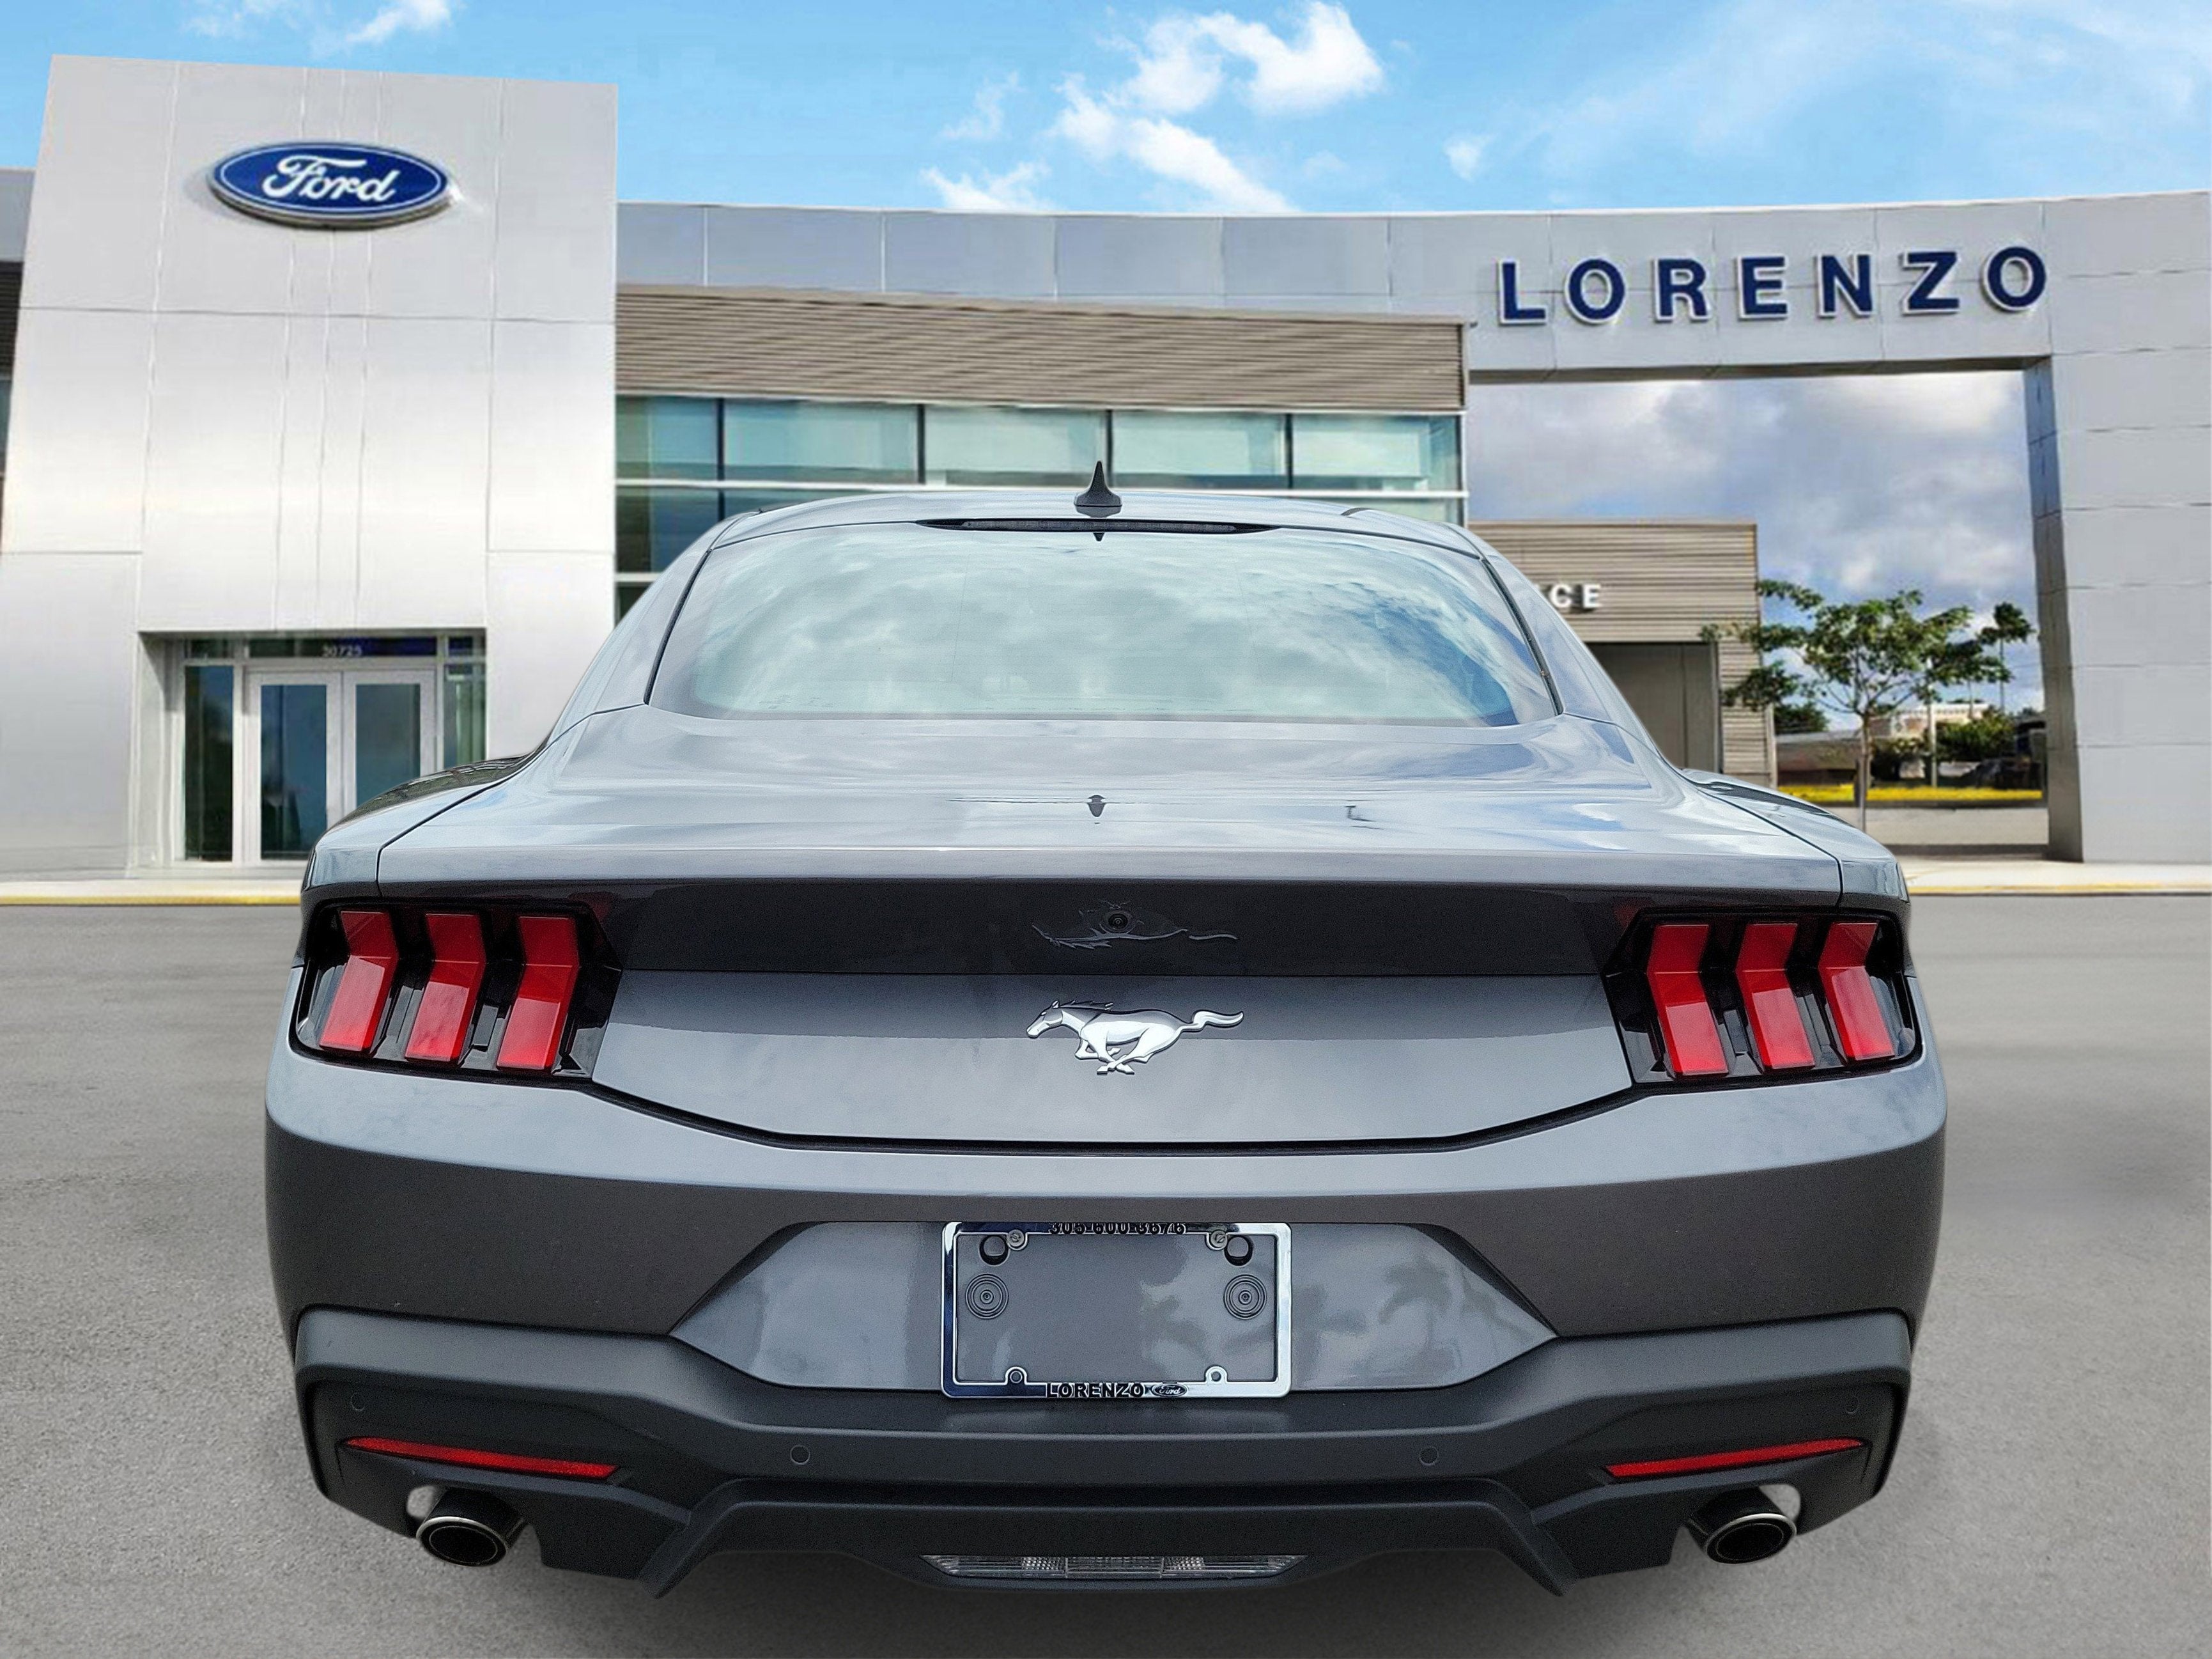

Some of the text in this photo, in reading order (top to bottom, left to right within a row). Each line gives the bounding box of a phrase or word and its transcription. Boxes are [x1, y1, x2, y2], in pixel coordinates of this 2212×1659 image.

[262, 155, 400, 201] Ford
[1497, 246, 2046, 324] LORENZO
[1534, 584, 1600, 608] CE
[1046, 1382, 1145, 1398] LORENZO
